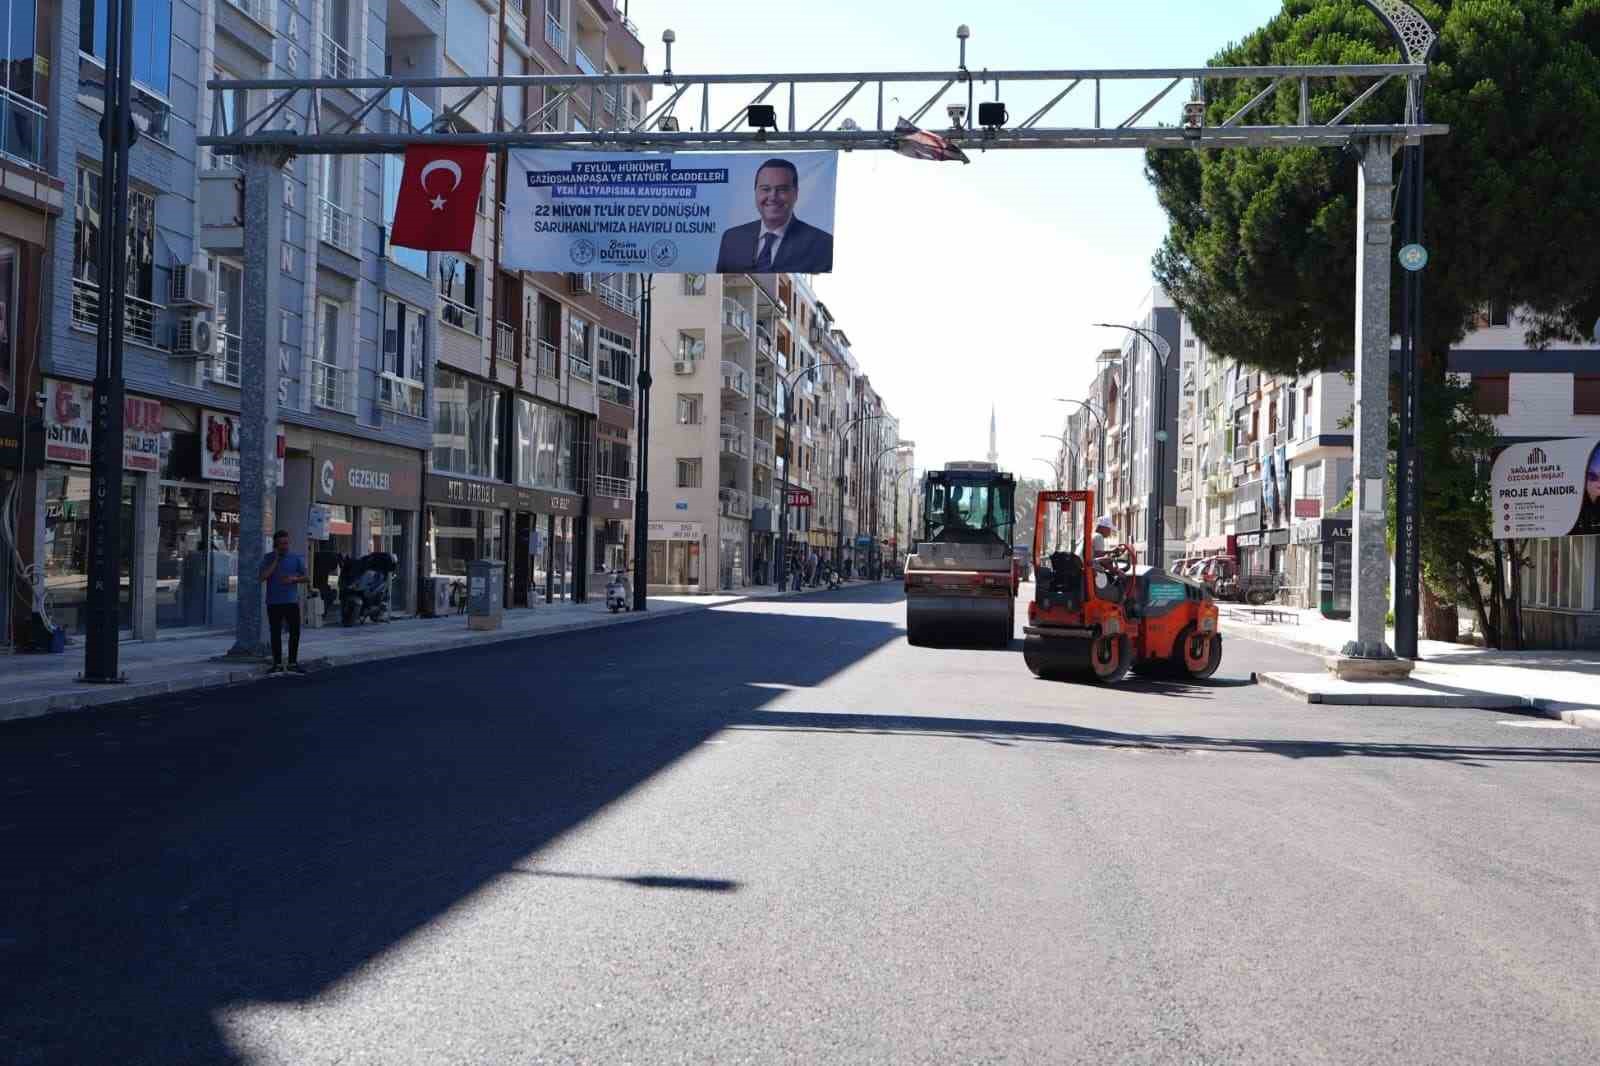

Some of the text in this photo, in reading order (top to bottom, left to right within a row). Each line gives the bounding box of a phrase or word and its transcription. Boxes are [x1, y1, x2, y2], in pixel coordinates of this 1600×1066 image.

[576, 164, 582, 173] 7
[530, 170, 725, 185] GAZİOSMANPAŞA VE ATATÜRK CADDELERİ
[580, 186, 635, 196] ALTYAPISINA
[638, 186, 692, 197] KAVUŞUYOR
[535, 201, 710, 219] 22 MİLYON TL'LİK DEV DÖNÜŞÜM
[534, 221, 717, 233] SARUHANLI'MIZA HAYIRLI OLSUN!
[600, 249, 647, 260] DUTLULU
[1499, 485, 1578, 498] PROJE ALANIDIR.
[1331, 527, 1353, 537] ALT
